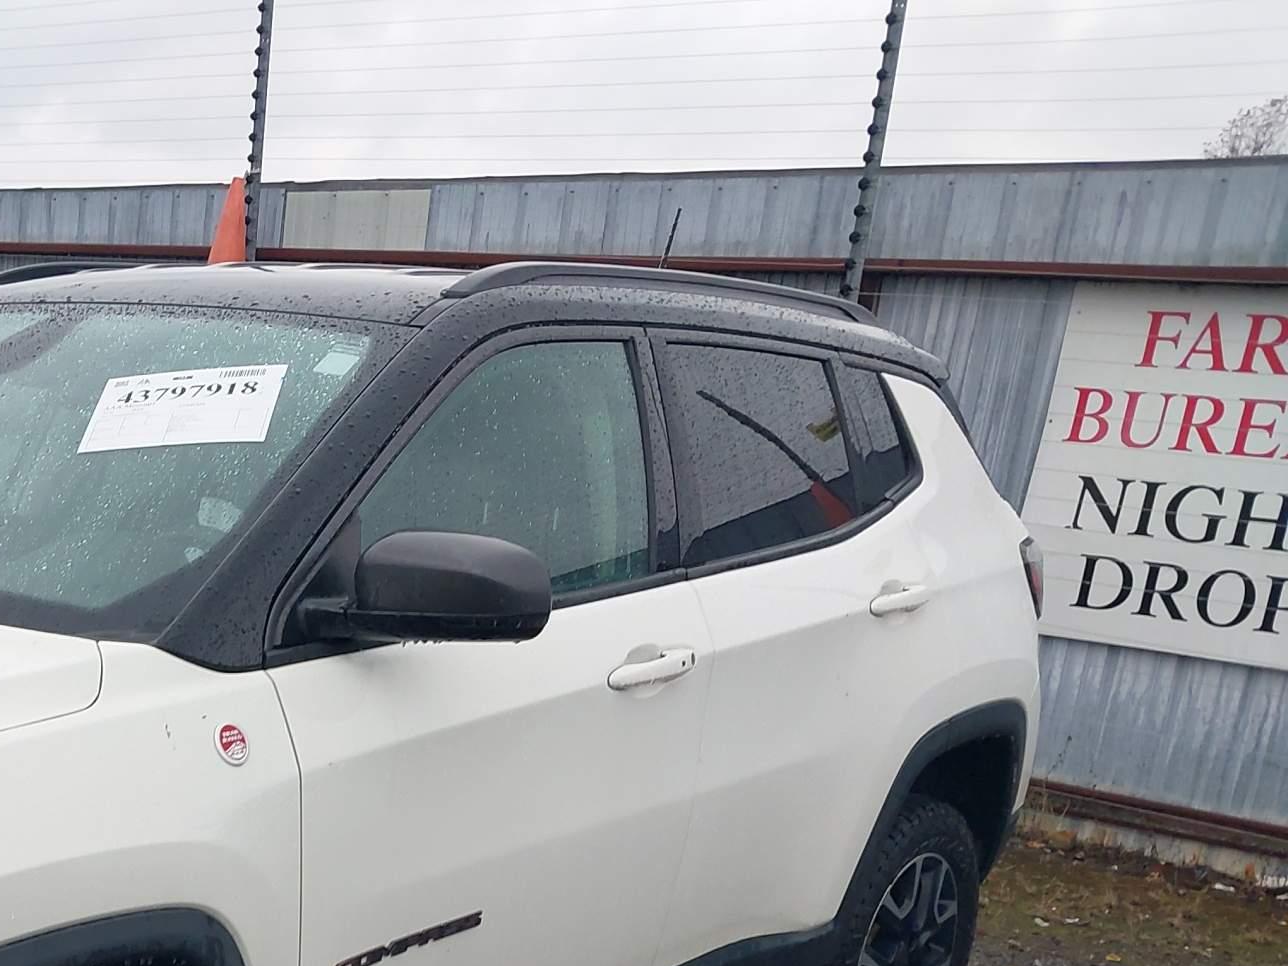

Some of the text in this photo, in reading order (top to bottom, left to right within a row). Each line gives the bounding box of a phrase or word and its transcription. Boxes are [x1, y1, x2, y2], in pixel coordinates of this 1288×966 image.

[1134, 310, 1288, 376] FAR
[116, 380, 259, 404] 43797918
[1062, 386, 1288, 460] BURE
[1064, 475, 1288, 552] NIGH
